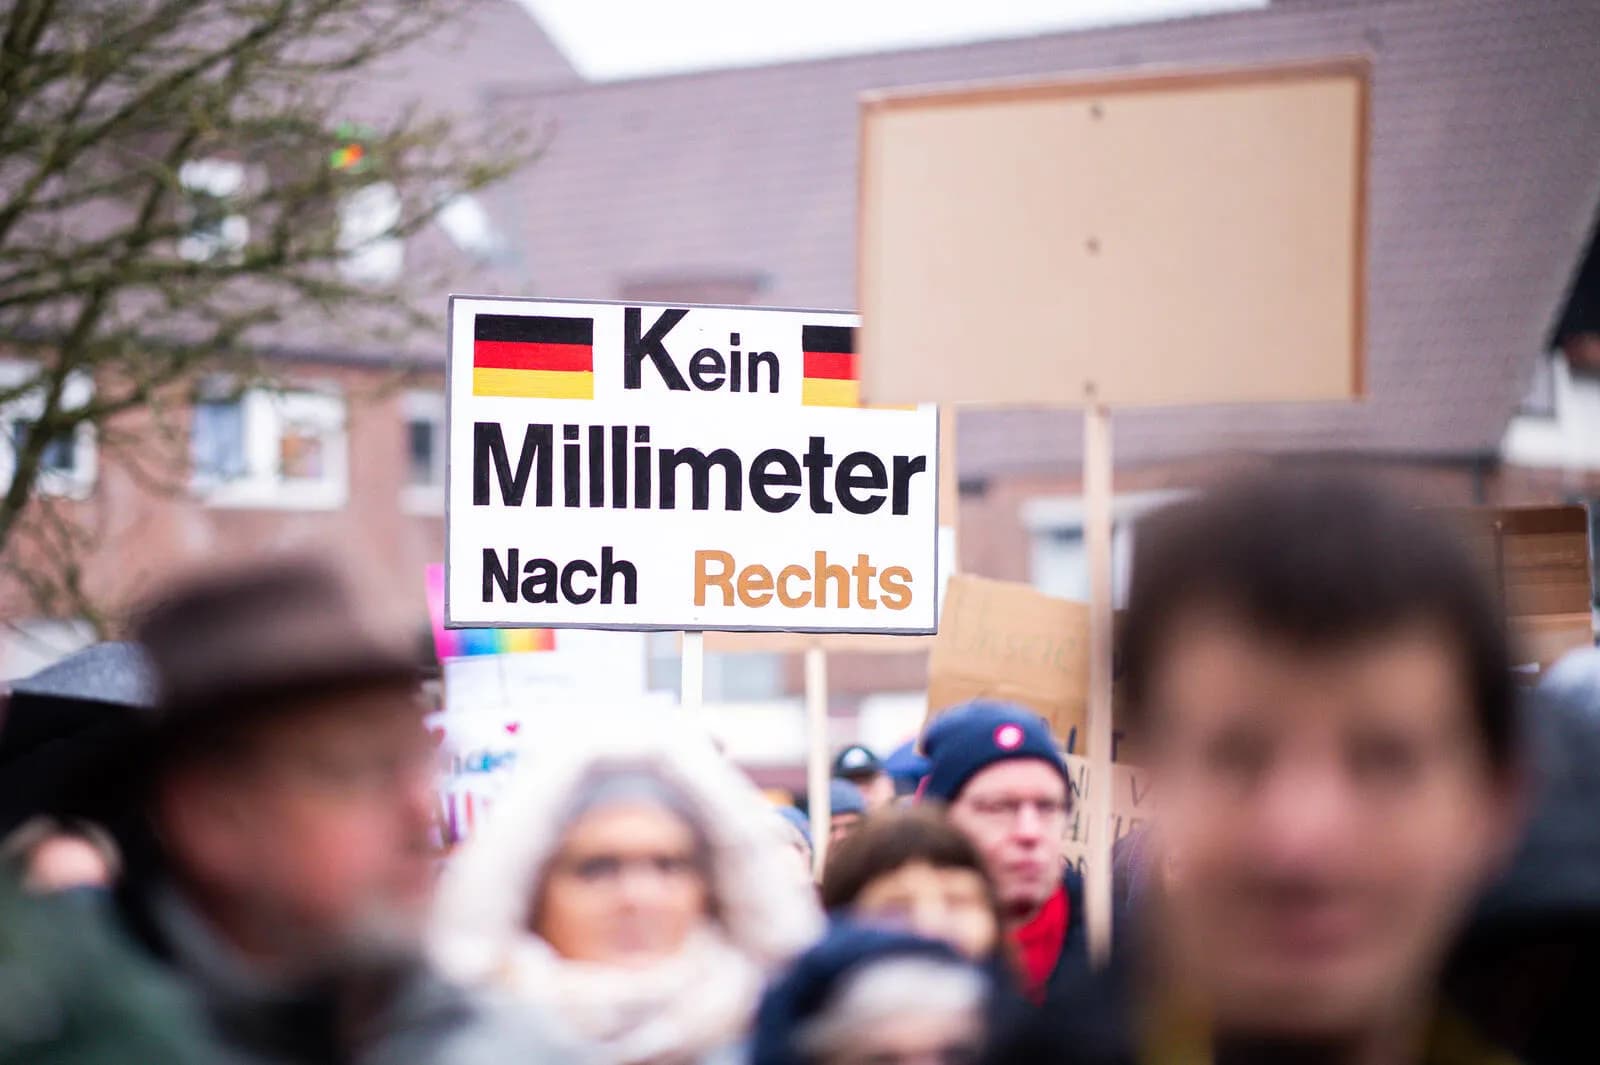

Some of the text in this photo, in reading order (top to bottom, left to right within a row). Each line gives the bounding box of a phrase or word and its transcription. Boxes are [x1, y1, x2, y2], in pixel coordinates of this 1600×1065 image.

[623, 307, 780, 393] Kein
[473, 421, 927, 516] Millimeter
[482, 546, 913, 610] Nach Rechts
